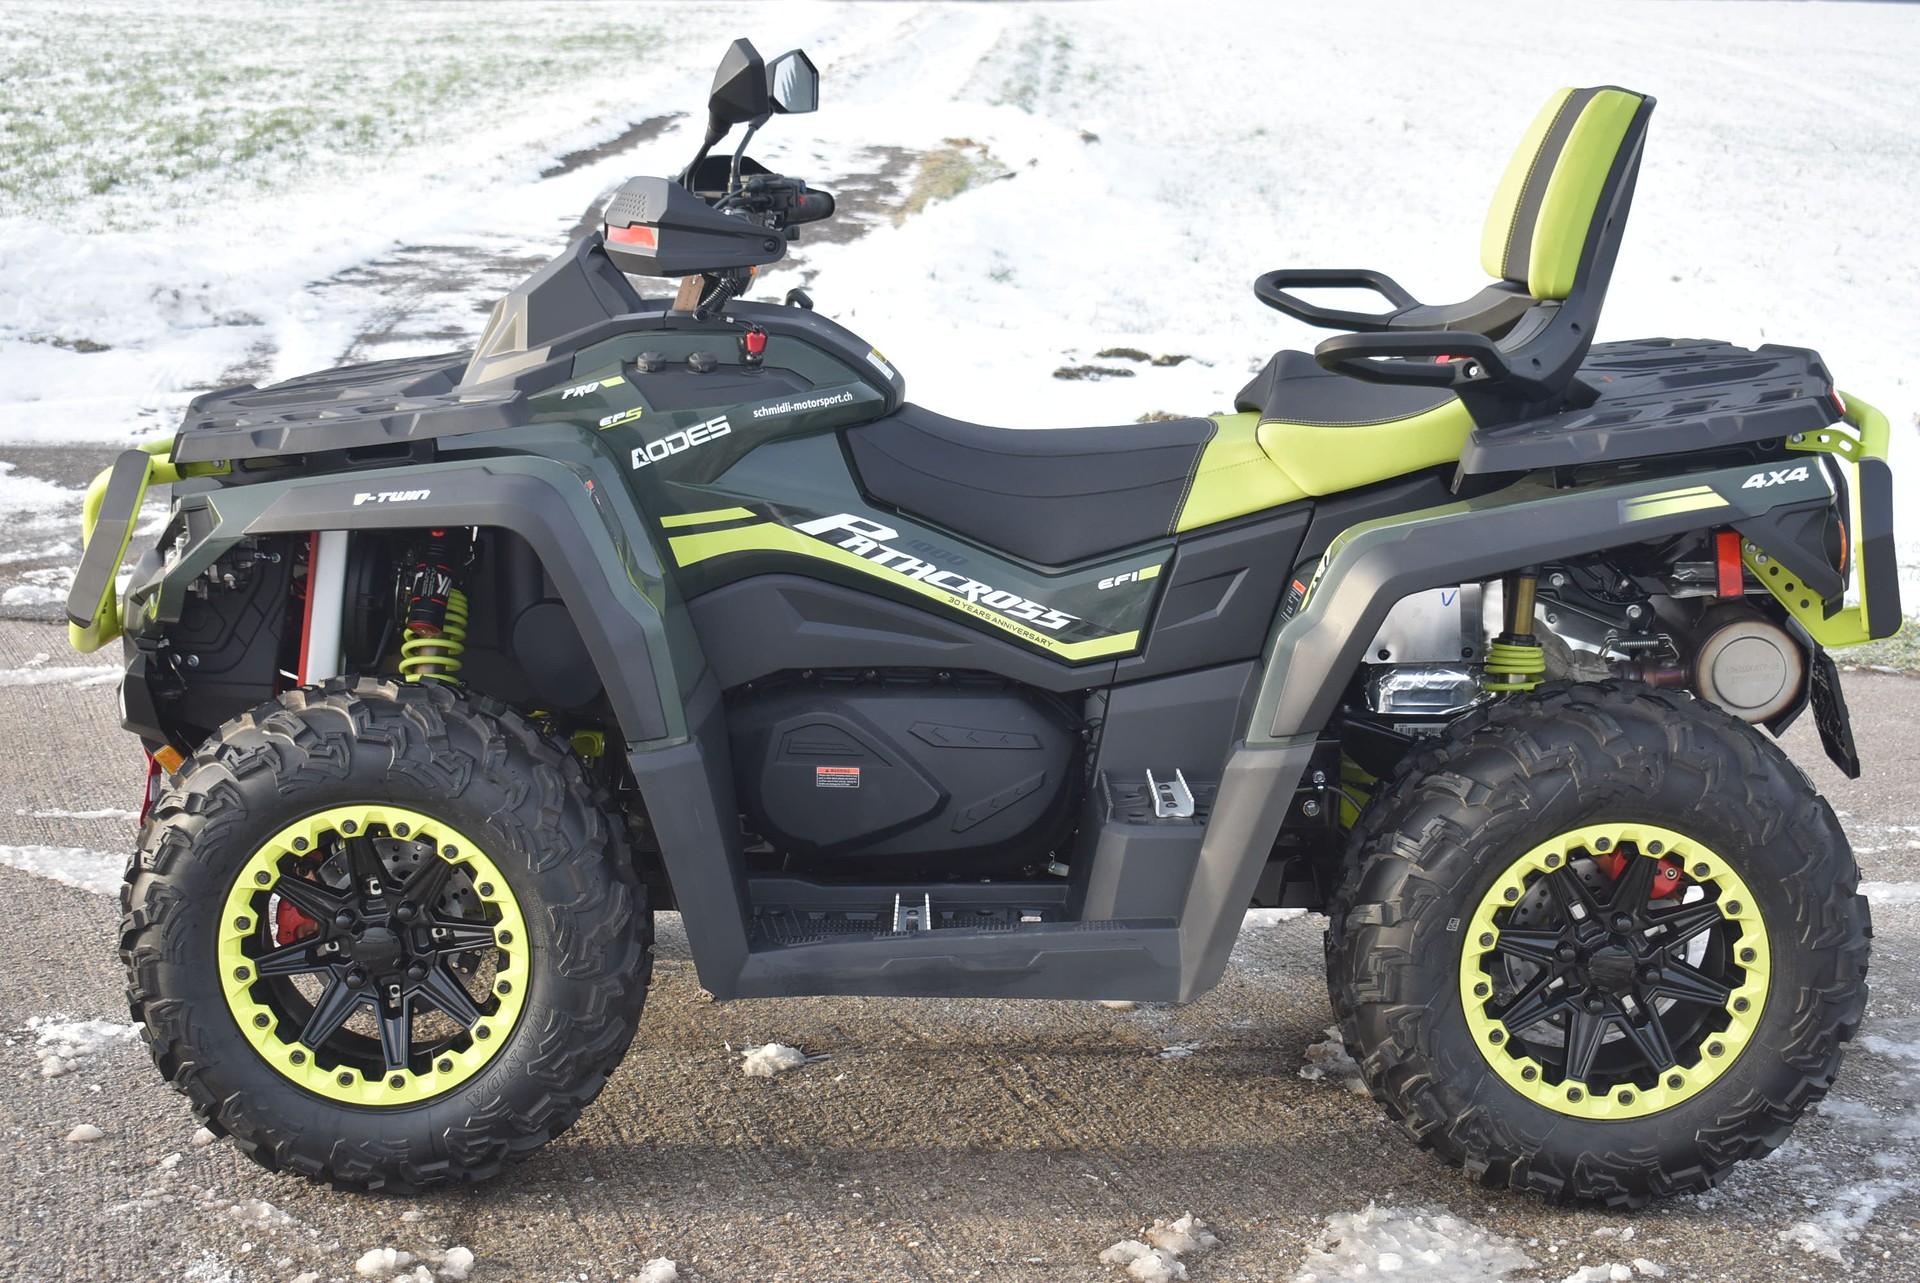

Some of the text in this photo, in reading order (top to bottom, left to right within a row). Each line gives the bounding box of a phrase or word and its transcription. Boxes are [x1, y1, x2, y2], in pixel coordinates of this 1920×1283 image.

[561, 382, 599, 399] PRO
[599, 407, 642, 428] EPS
[753, 391, 853, 418] schmidli-motorsport.ch
[632, 415, 732, 470] AODES
[1741, 466, 1809, 489] 4X4
[907, 540, 970, 565] 1000
[793, 513, 1081, 630] PATHCROSS
[1097, 571, 1138, 590] EFI
[948, 596, 1054, 647] 30 YEARS ANNIVERSARY
[464, 1005, 548, 1108] WANDA
